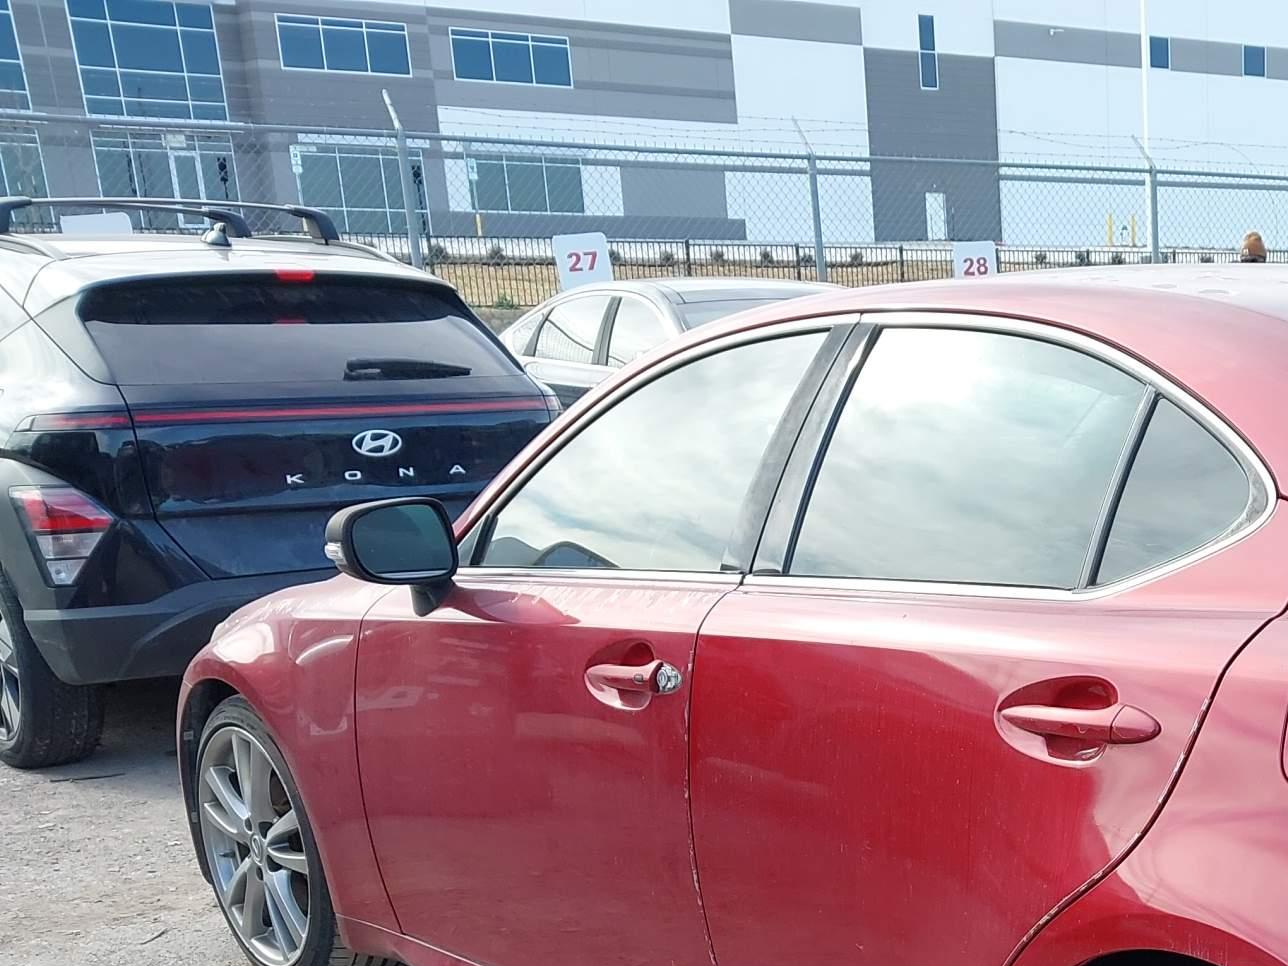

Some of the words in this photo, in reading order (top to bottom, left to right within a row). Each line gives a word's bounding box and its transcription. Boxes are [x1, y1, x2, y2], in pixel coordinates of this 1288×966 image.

[567, 250, 598, 272] 27
[963, 257, 989, 277] 28
[285, 464, 466, 485] KONA
